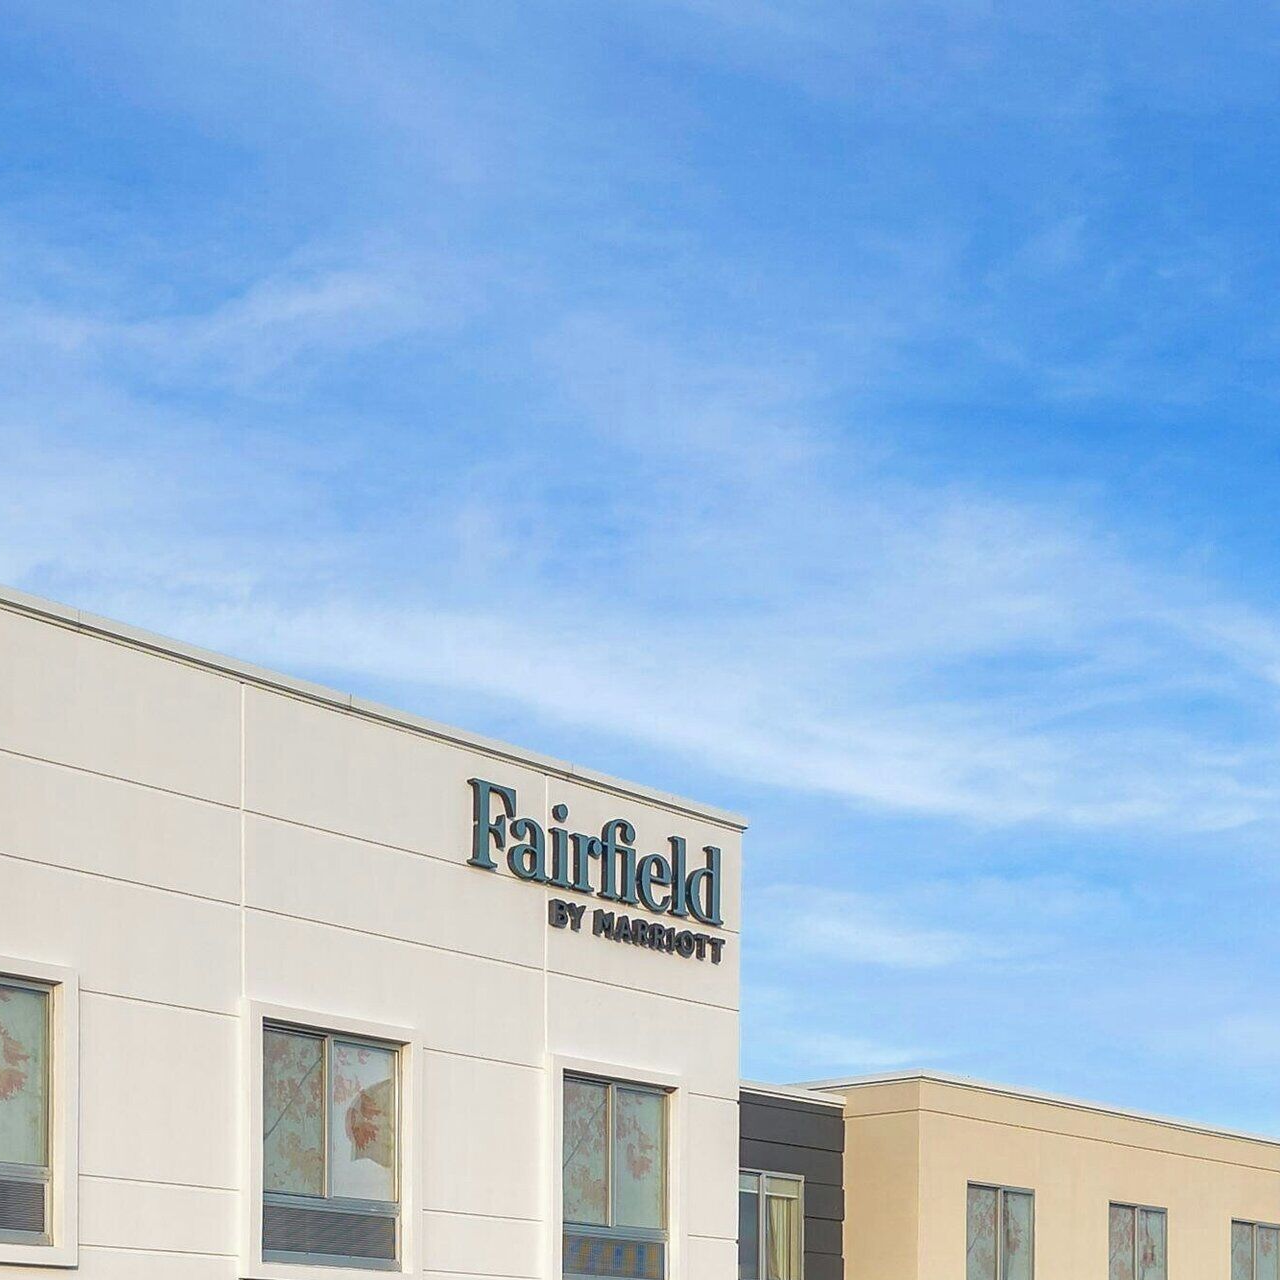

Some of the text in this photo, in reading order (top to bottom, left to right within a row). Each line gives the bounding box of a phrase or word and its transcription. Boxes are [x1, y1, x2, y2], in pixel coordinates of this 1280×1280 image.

[467, 778, 723, 926] Fairfield
[549, 898, 725, 964] BY MARRIOTT
